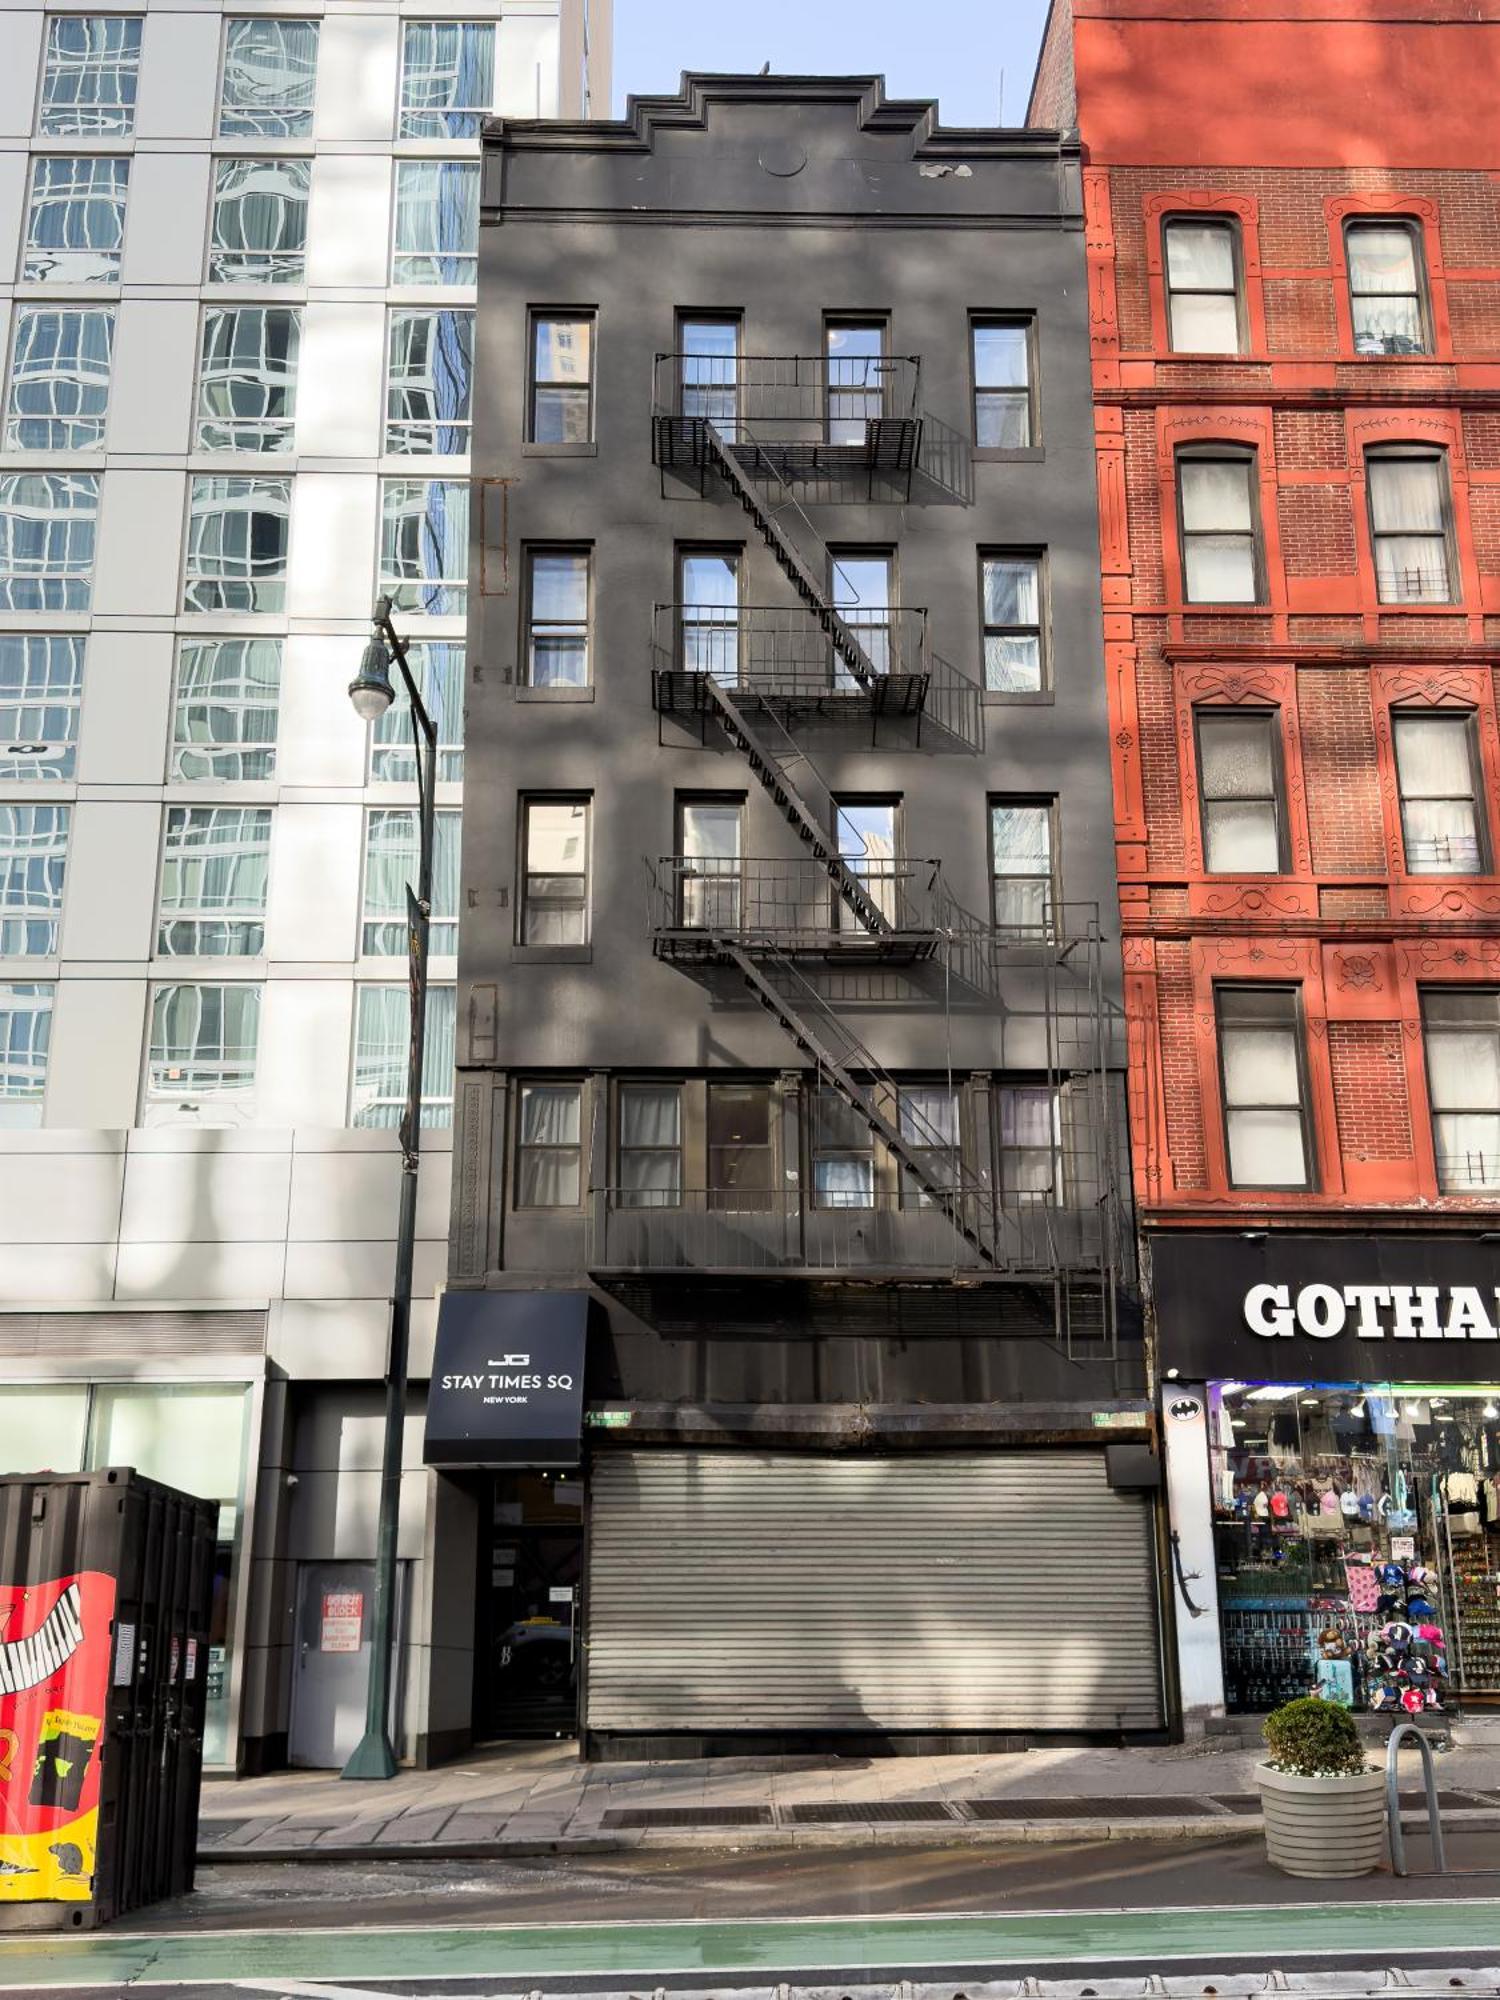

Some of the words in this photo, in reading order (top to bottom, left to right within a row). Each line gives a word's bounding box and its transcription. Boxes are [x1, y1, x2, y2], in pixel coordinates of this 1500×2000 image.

[1244, 1283, 1500, 1339] GOTHA
[441, 1375, 484, 1389] STAY
[488, 1375, 542, 1389] TIMES
[547, 1375, 573, 1390] SQ
[483, 1396, 504, 1404] NEW
[505, 1396, 528, 1404] YORK
[327, 1606, 358, 1616] BLOCK
